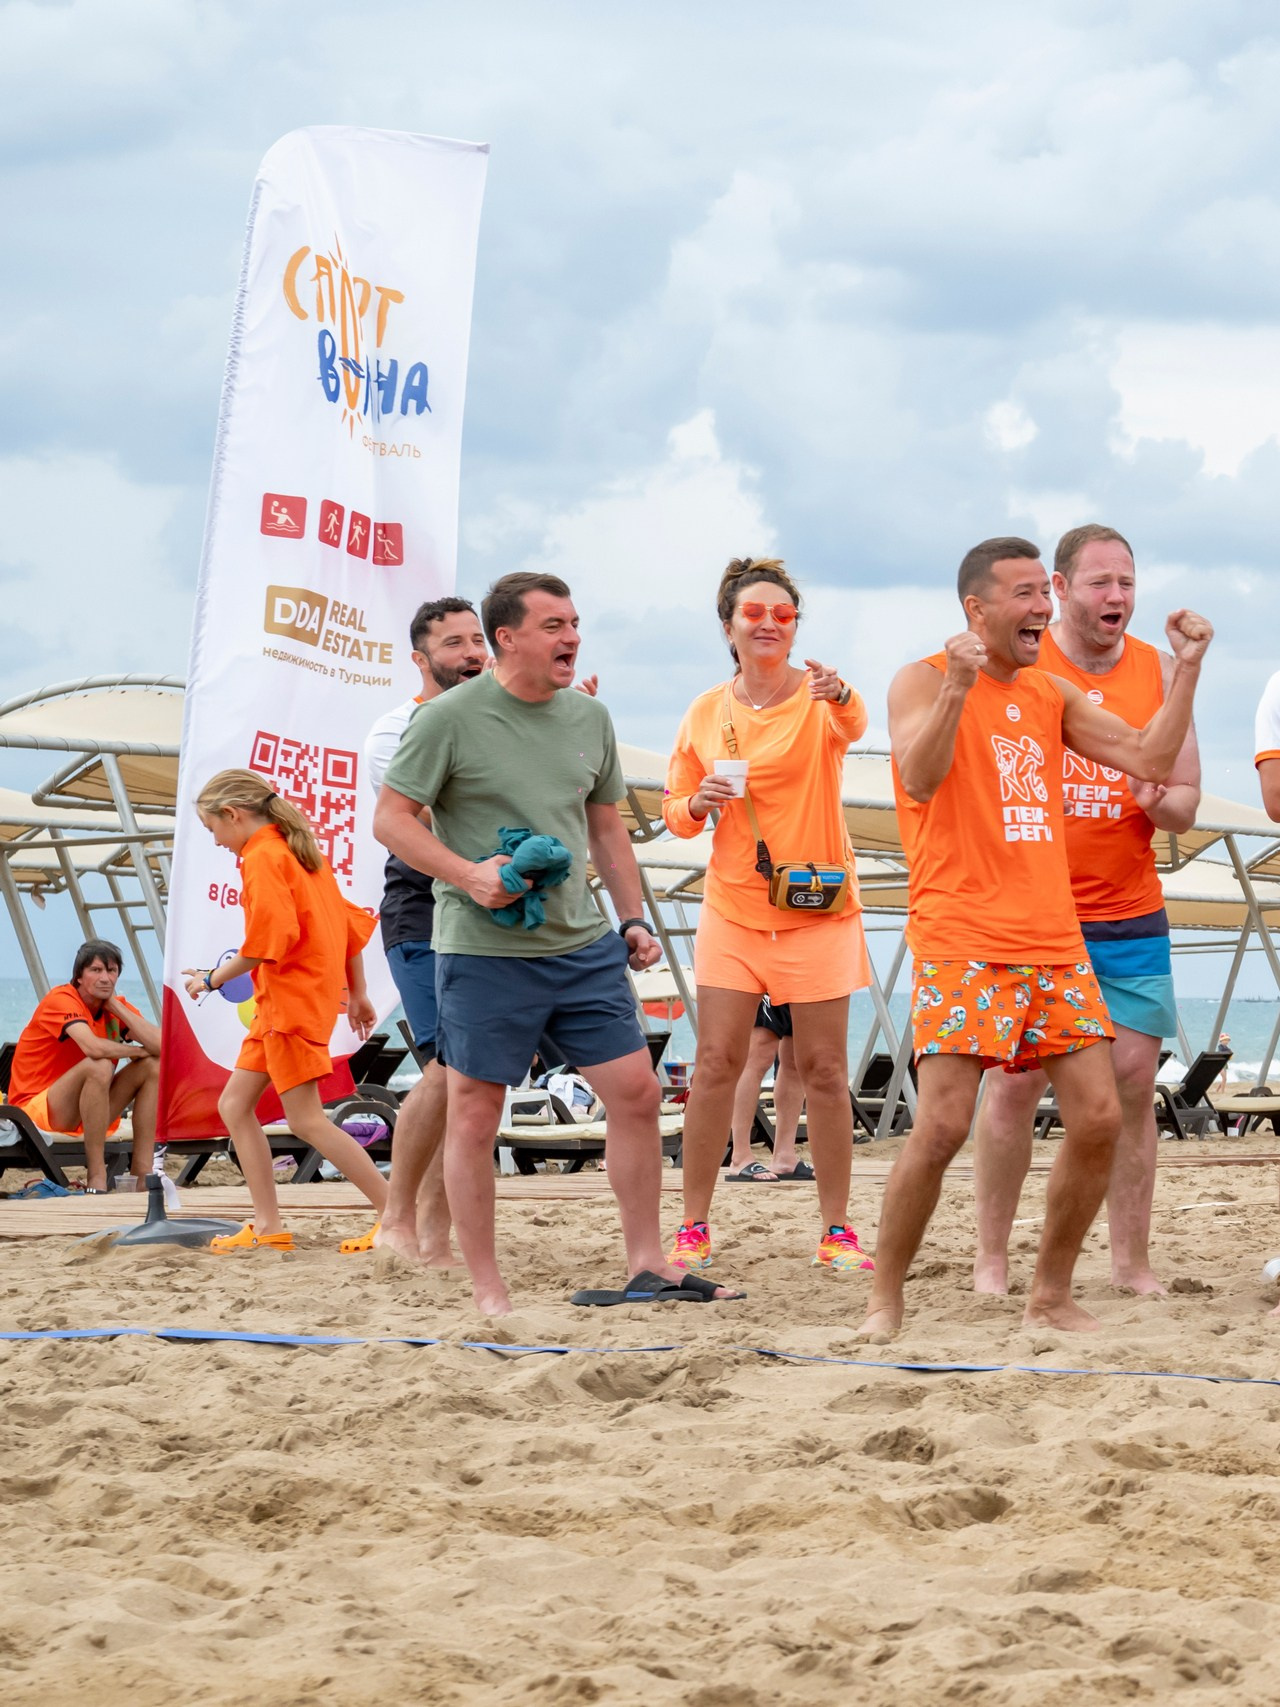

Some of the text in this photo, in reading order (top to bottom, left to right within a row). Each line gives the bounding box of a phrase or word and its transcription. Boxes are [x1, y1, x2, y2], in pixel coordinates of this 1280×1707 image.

[273, 597, 320, 634] DDA
[329, 600, 367, 633] REAL
[322, 628, 393, 665] ESTATE
[262, 647, 328, 675] недвижимость
[339, 668, 391, 687] Турции
